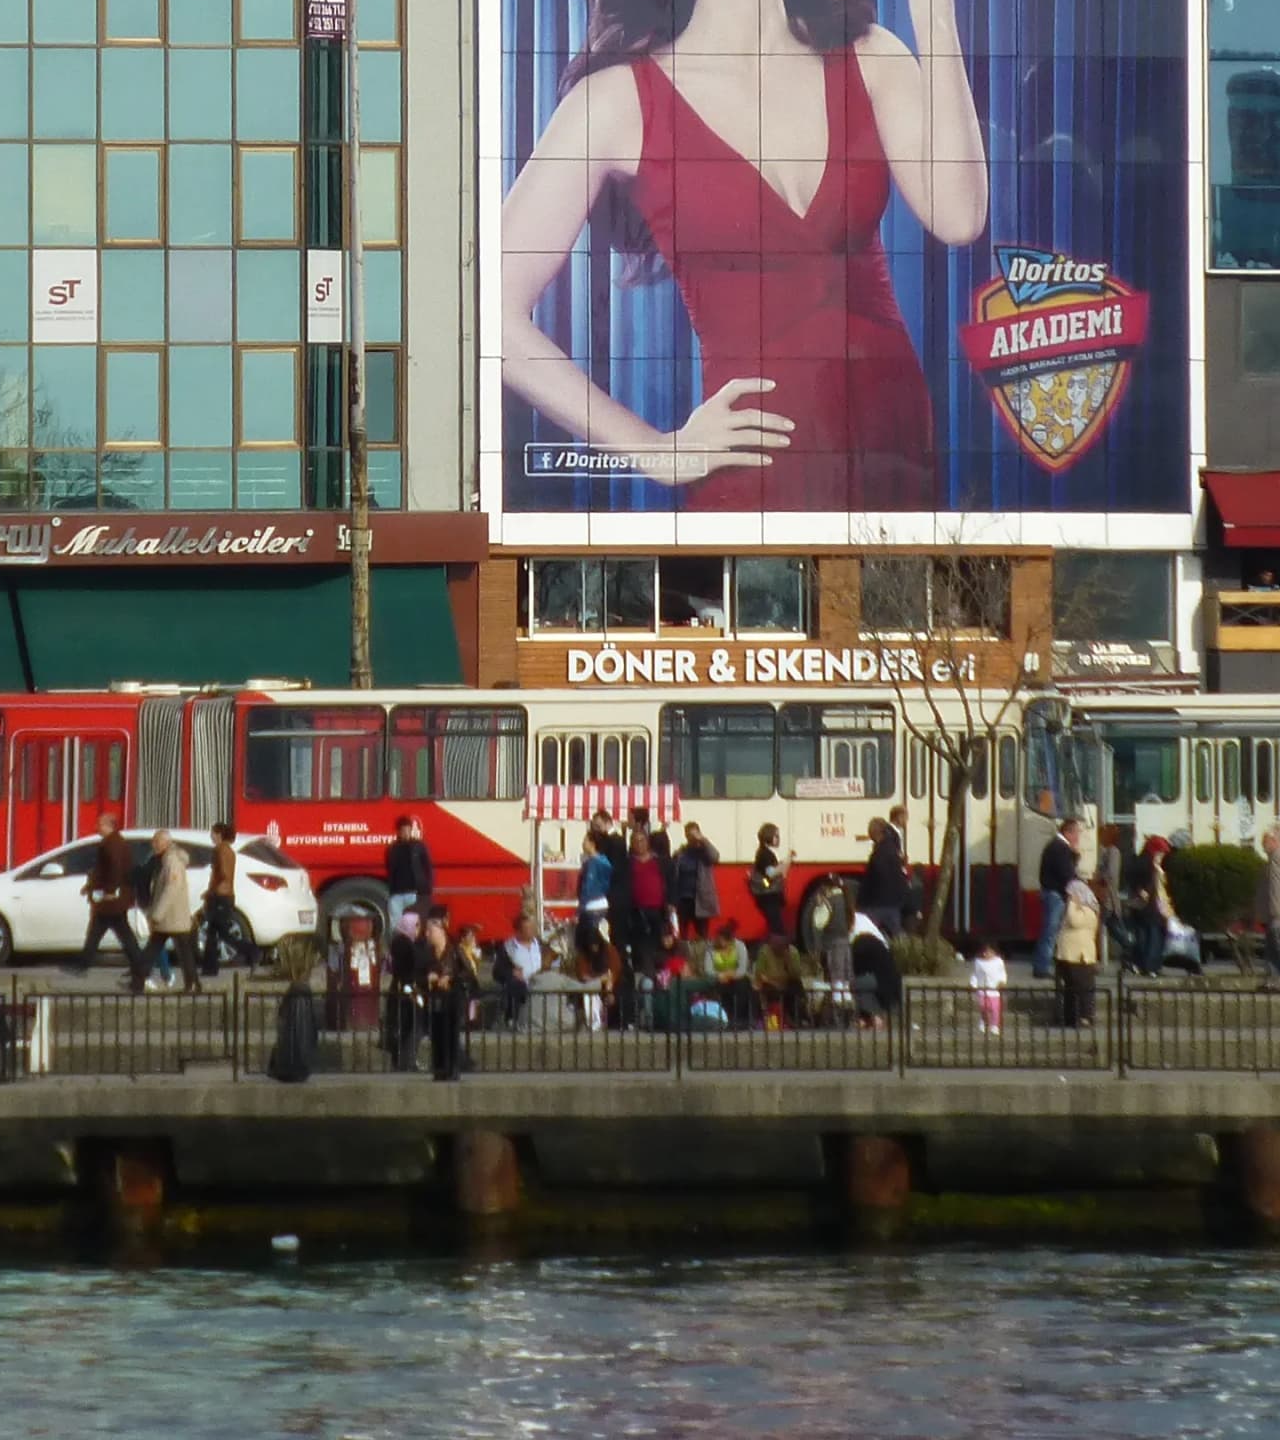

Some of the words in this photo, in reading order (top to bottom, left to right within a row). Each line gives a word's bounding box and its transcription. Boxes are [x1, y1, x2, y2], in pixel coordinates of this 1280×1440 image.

[1008, 255, 1105, 282] Doritos
[54, 525, 315, 556] Muhallebicileri
[567, 643, 698, 682] DÖNER
[708, 647, 736, 683] &
[931, 654, 976, 682] evi
[350, 834, 397, 845] BELEDİYE
